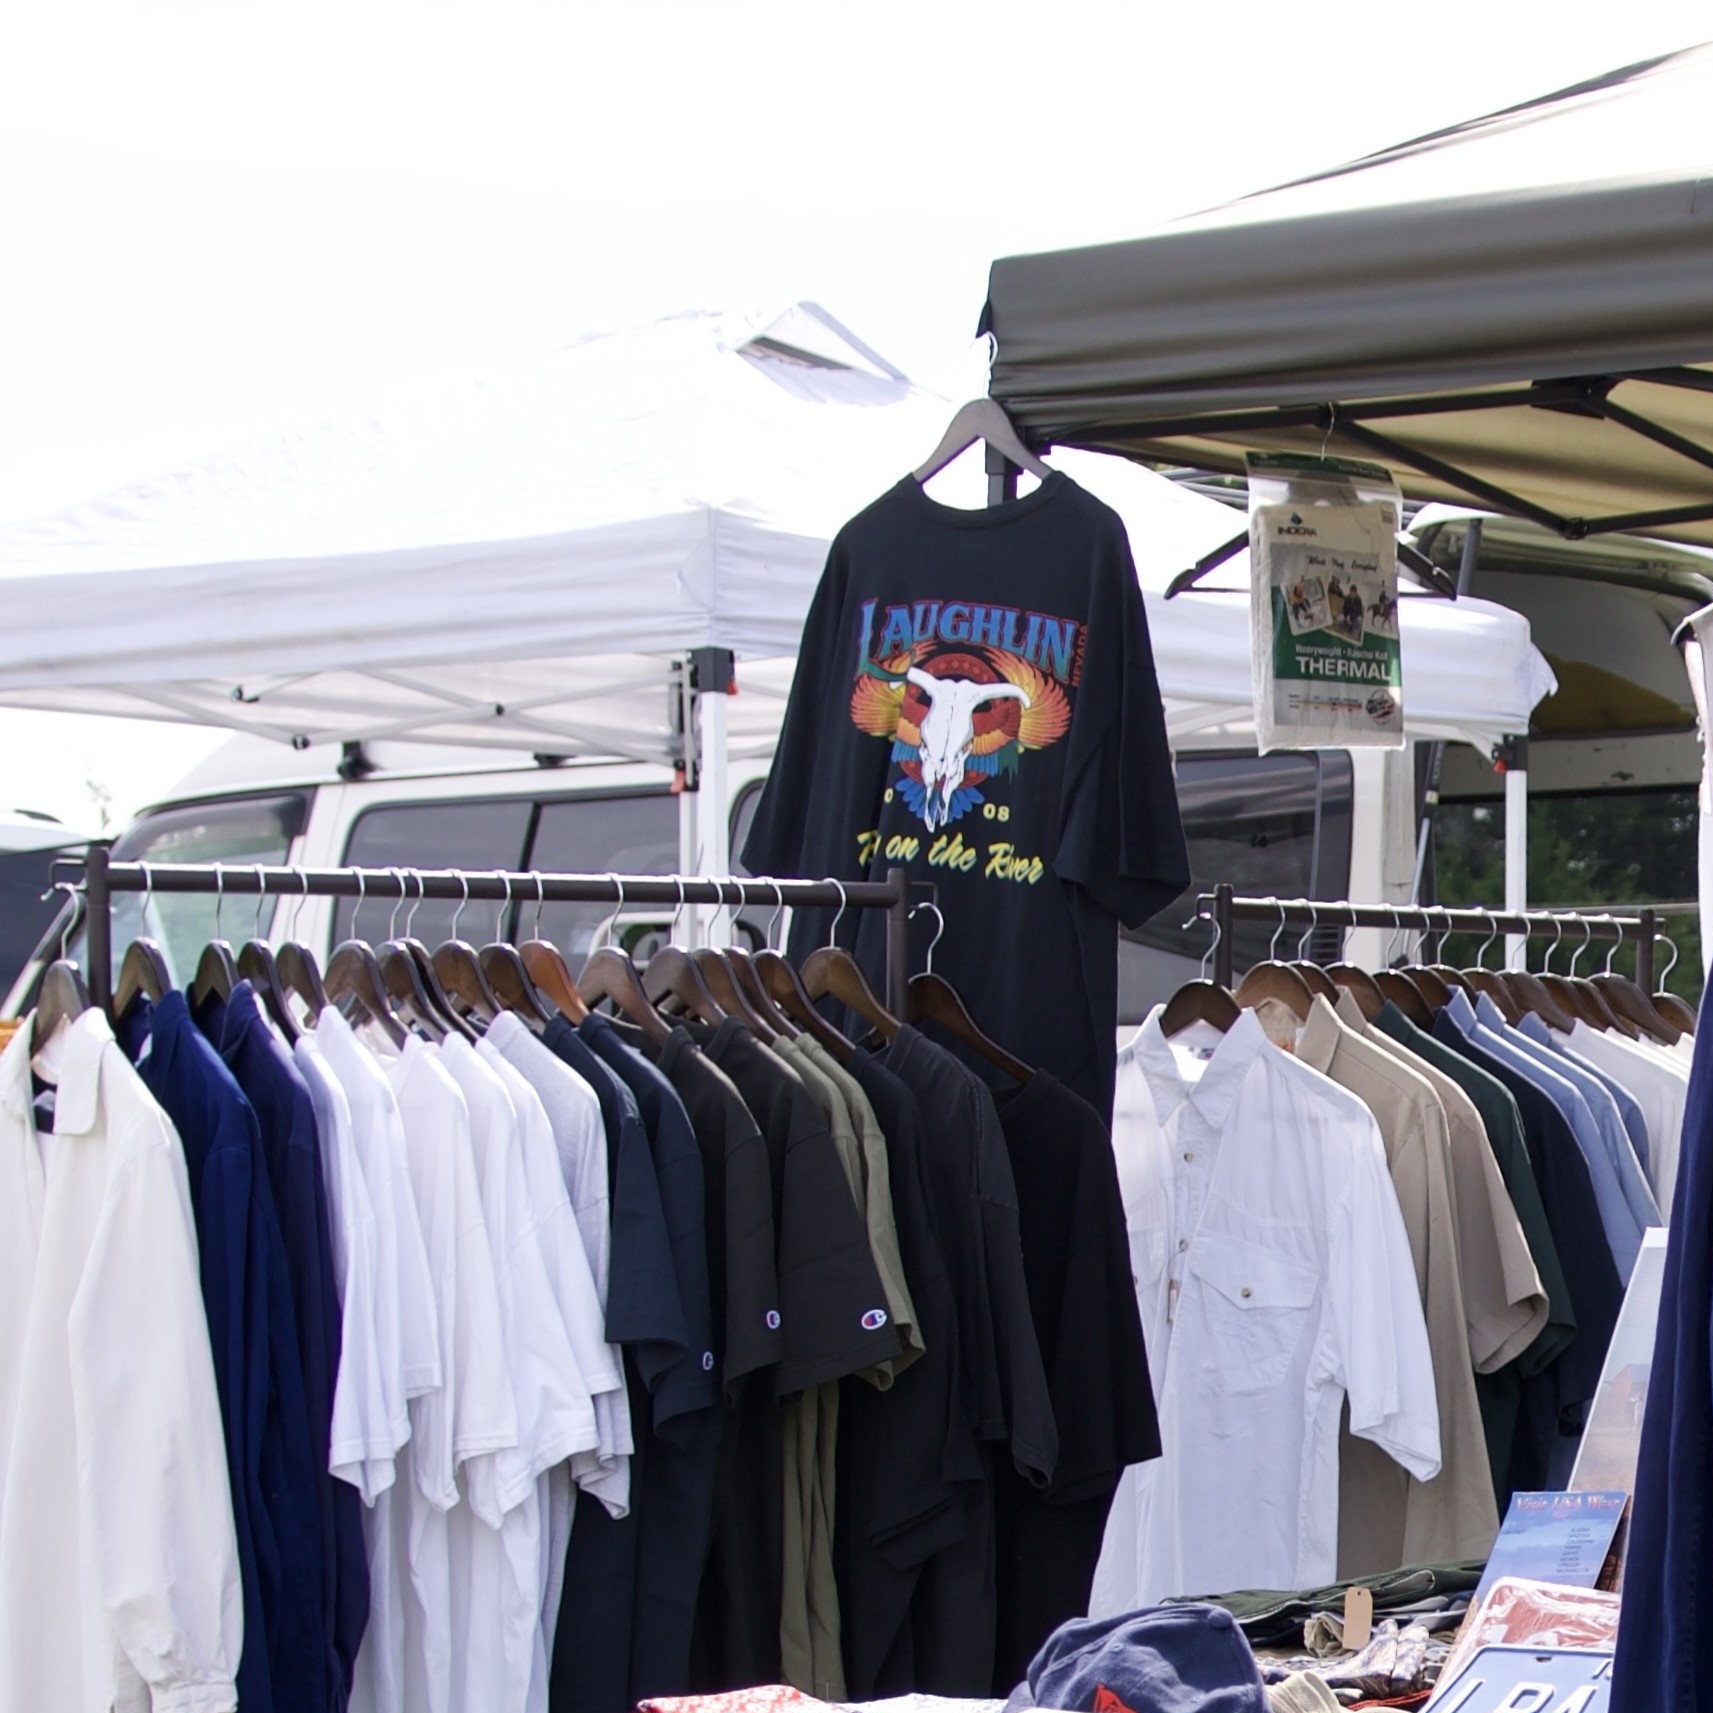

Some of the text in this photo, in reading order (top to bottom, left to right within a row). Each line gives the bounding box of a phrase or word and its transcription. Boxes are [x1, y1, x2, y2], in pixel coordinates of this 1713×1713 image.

[854, 597, 1079, 684] LAUGHLIN
[1295, 655, 1392, 680] THERMAL
[885, 834, 920, 862] on
[928, 832, 977, 872] the
